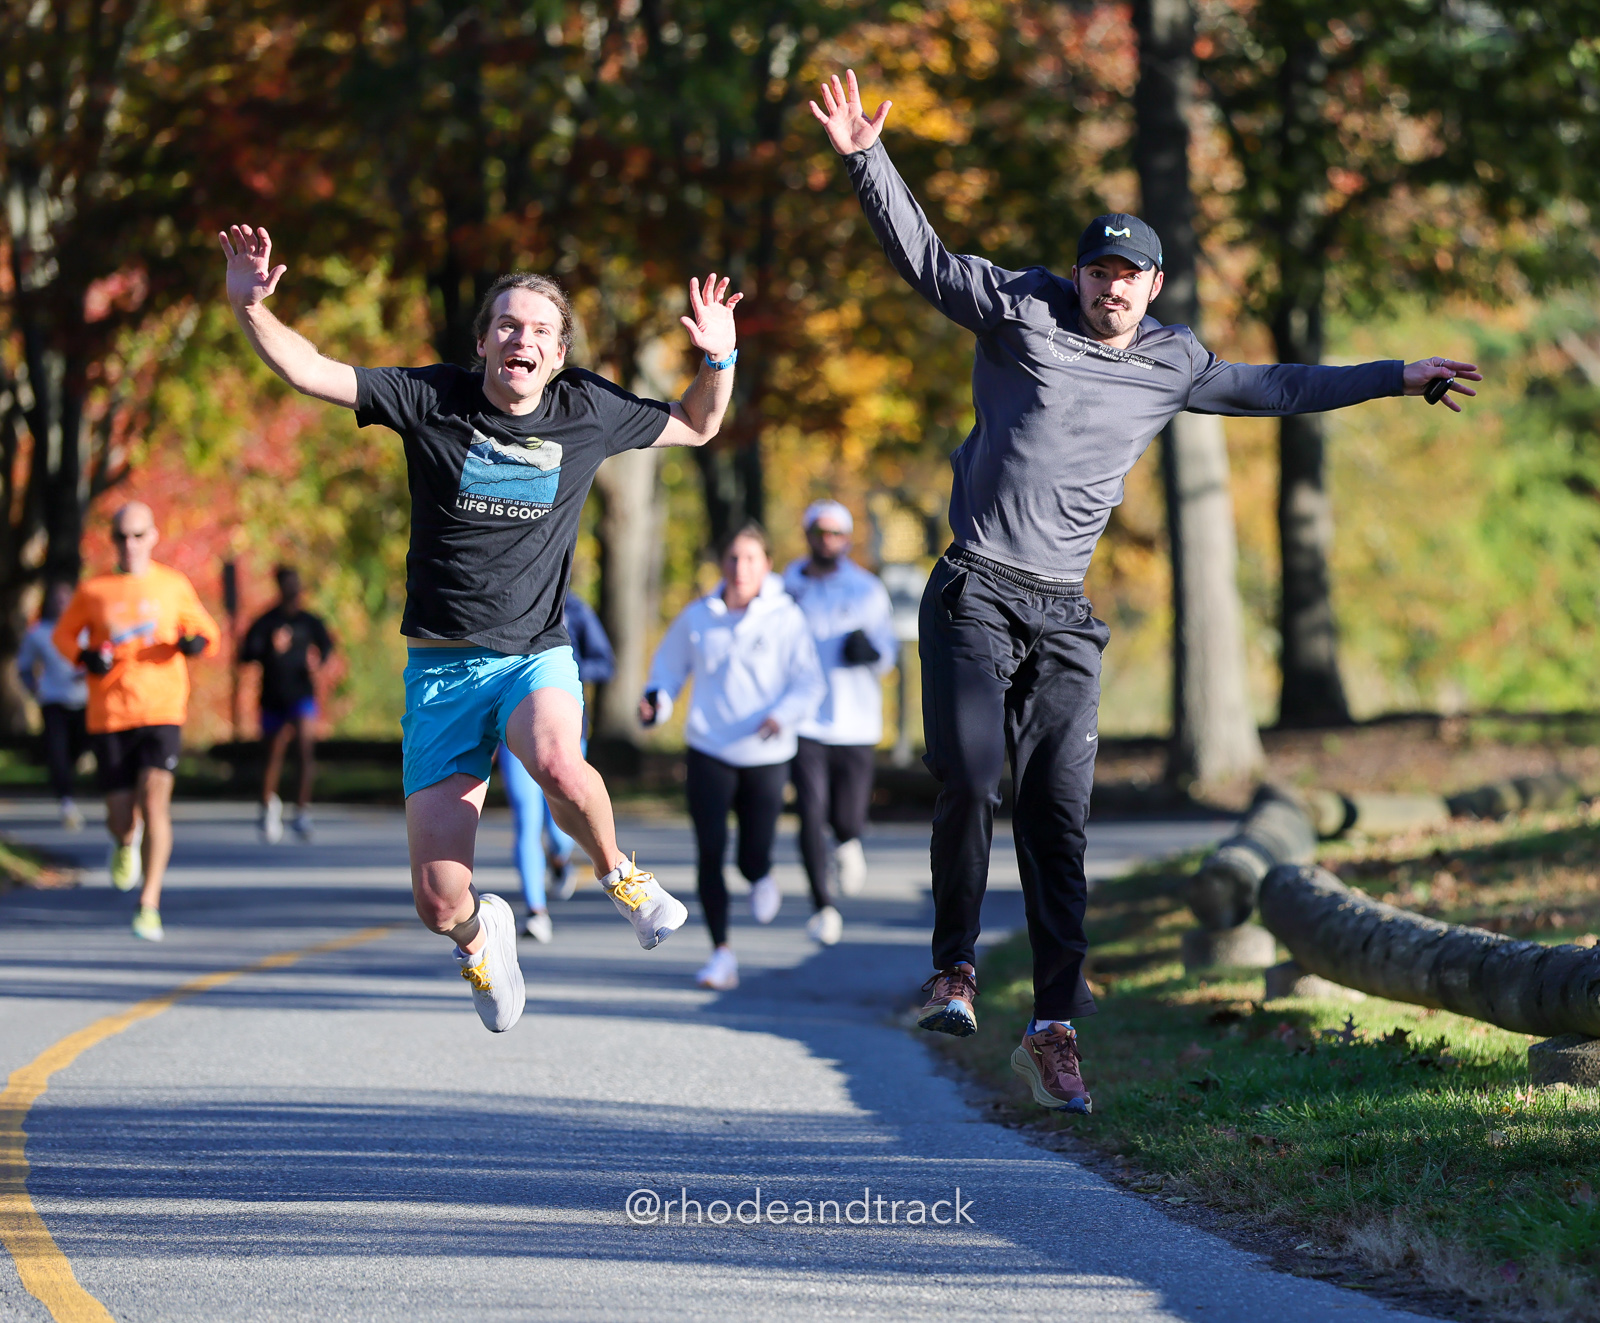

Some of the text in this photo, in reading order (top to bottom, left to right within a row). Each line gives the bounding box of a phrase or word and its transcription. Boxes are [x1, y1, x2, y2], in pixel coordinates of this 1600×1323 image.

[1066, 336, 1083, 348] Move
[1084, 343, 1098, 354] Your
[1127, 358, 1153, 370] Diabetes
[489, 503, 505, 516] IS
